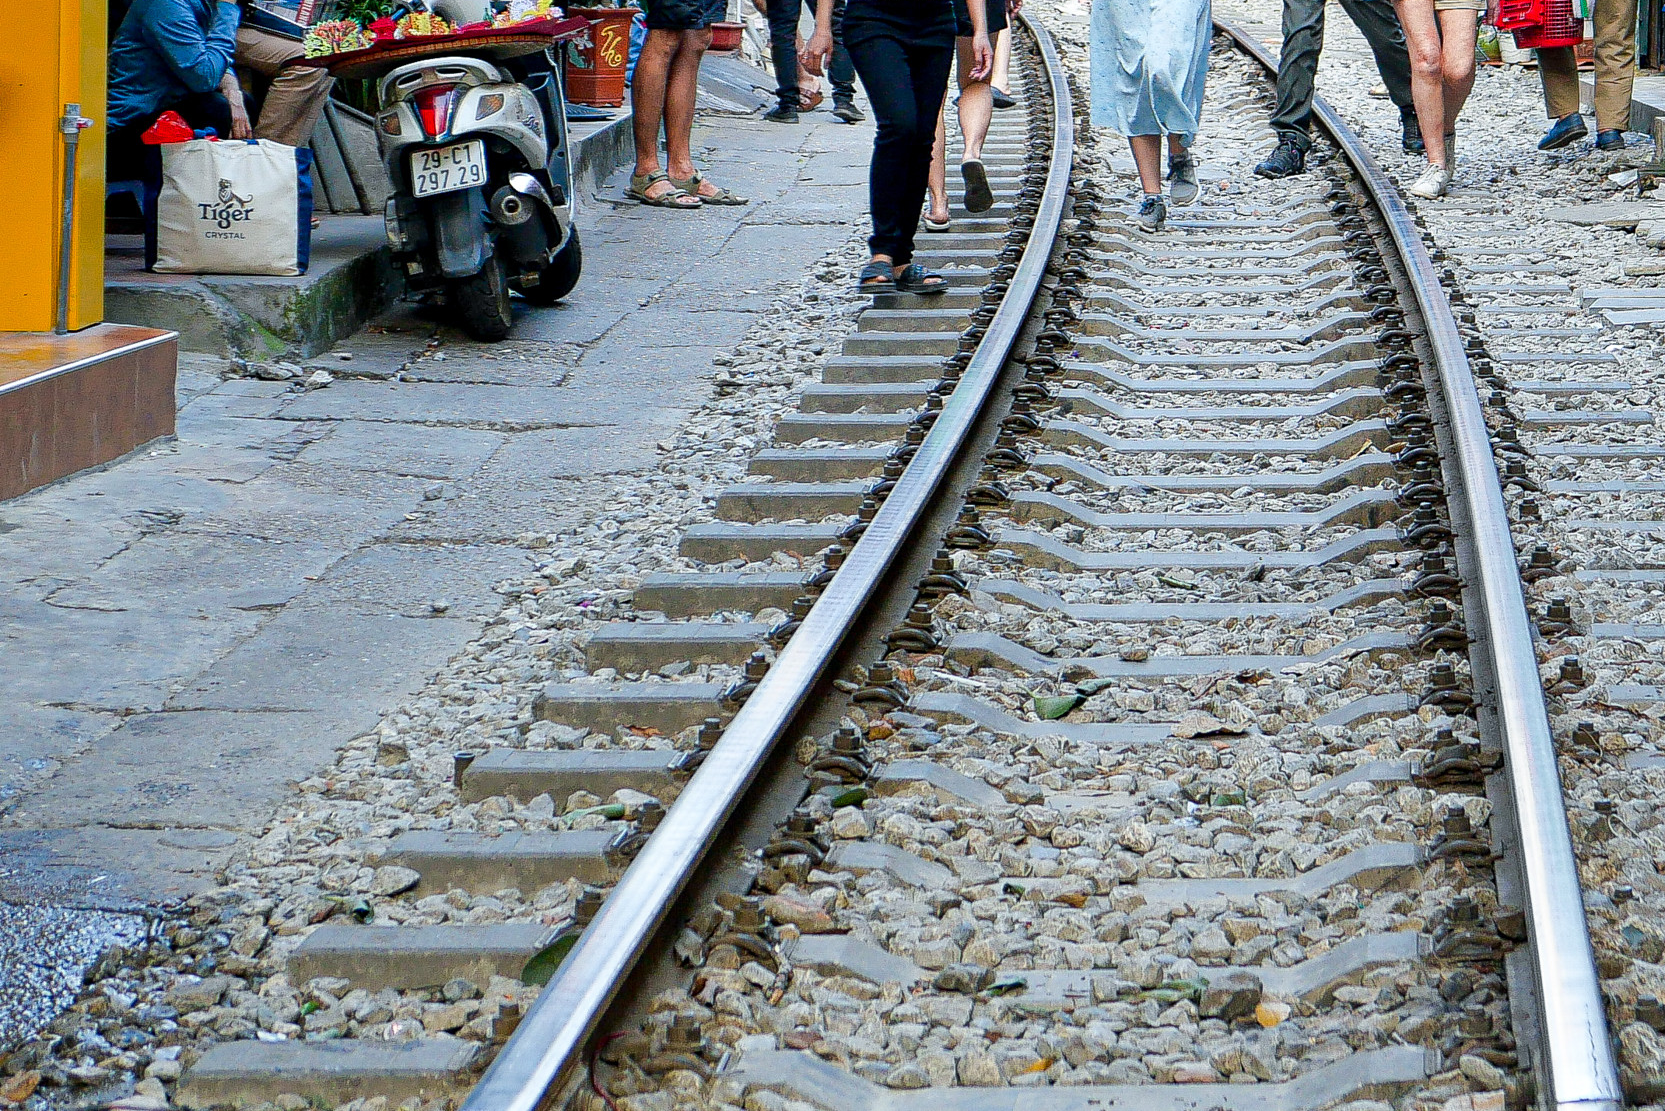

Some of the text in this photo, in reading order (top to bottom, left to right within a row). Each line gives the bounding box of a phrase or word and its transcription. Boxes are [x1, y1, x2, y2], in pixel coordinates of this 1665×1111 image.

[420, 144, 472, 172] 29-C1
[416, 164, 481, 194] 297.29
[197, 202, 255, 230] Tiger
[205, 231, 246, 240] CRYSTAL
